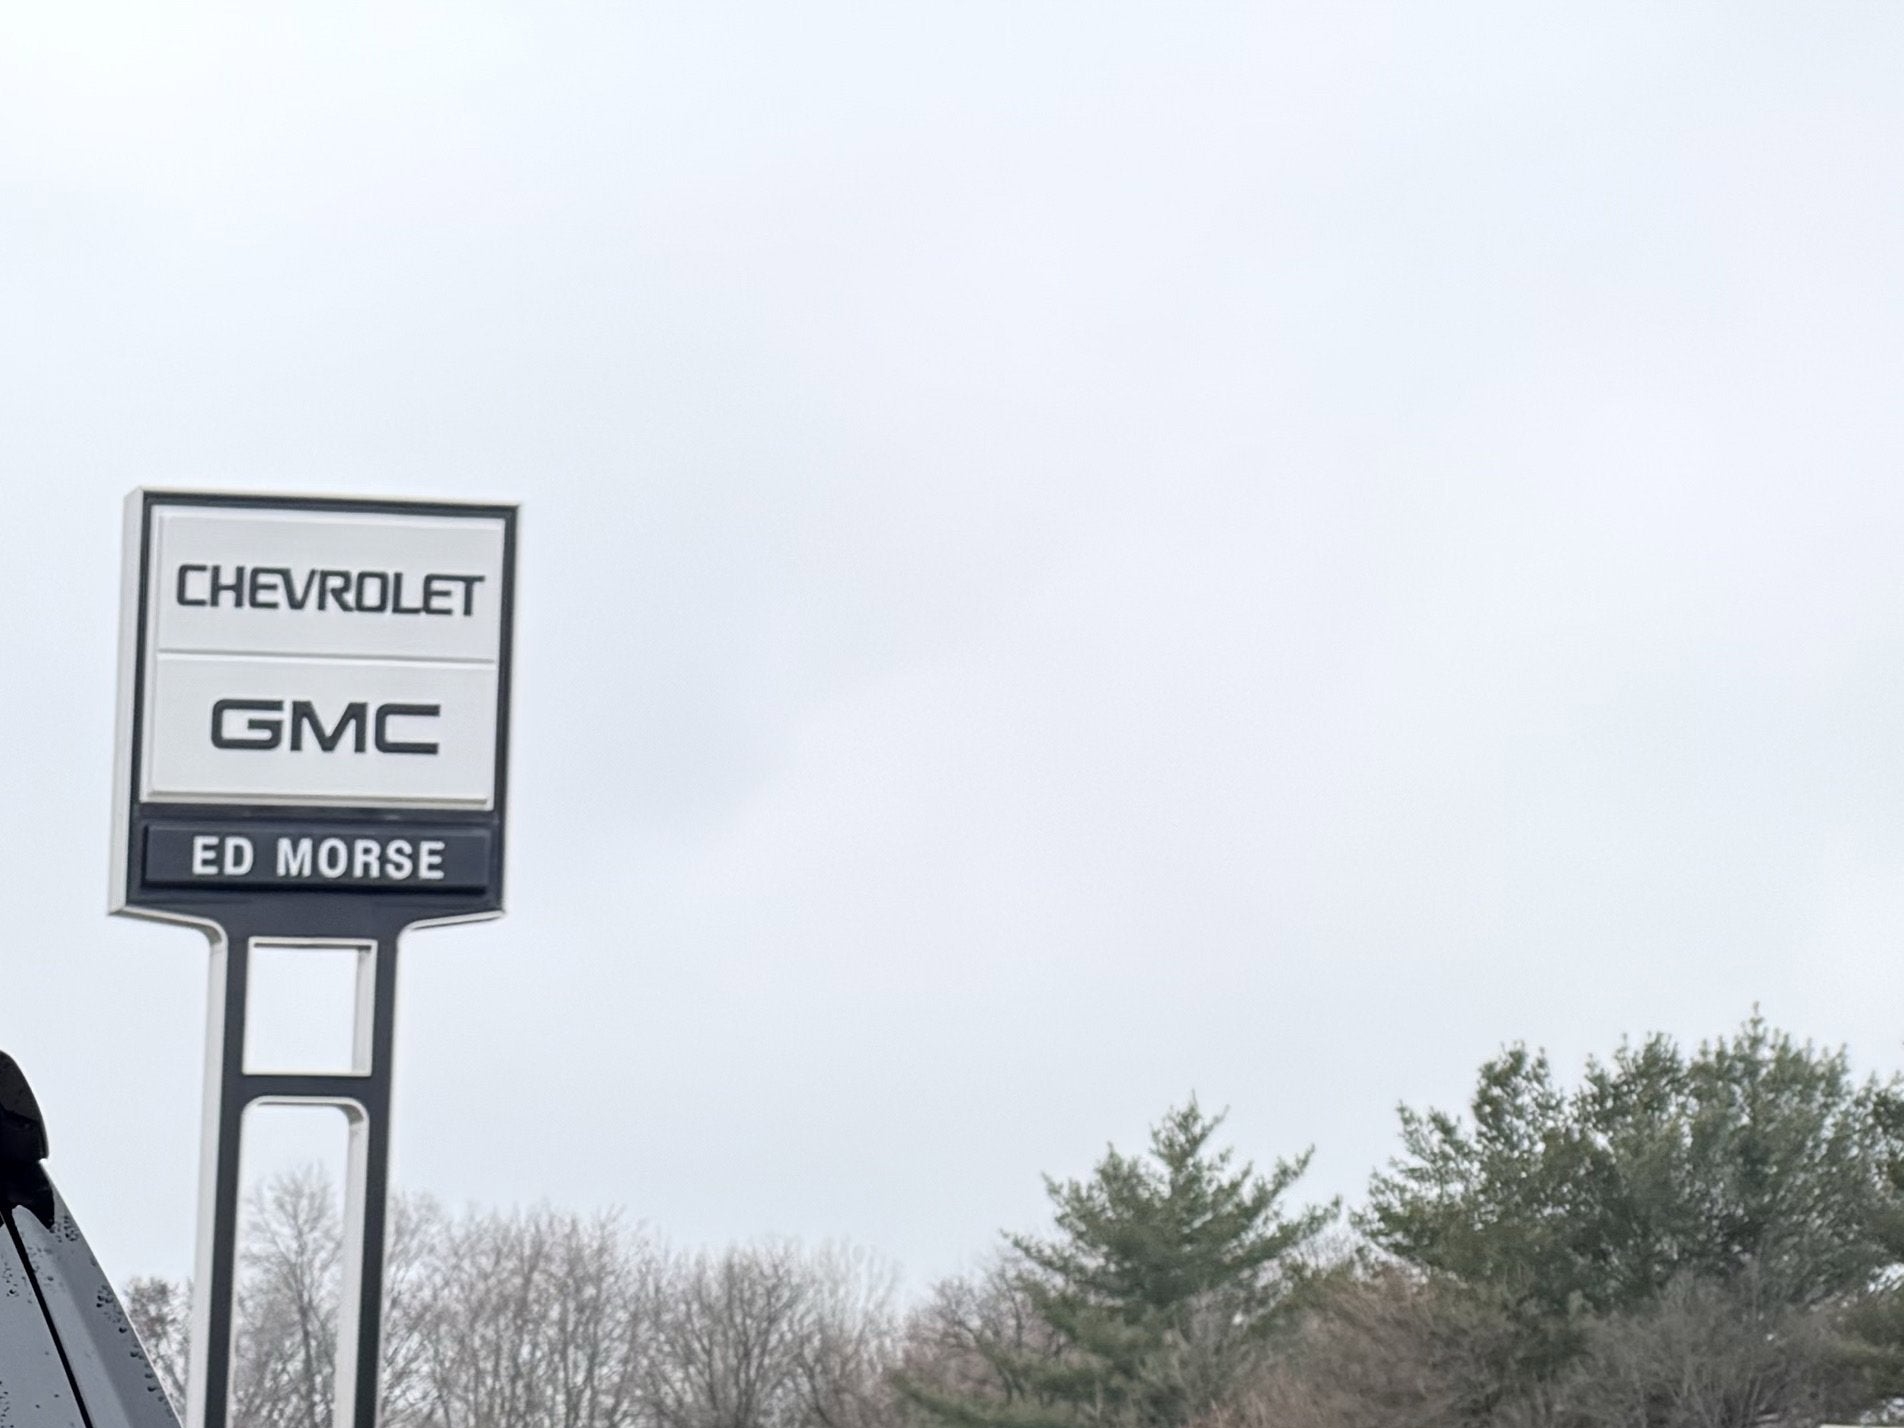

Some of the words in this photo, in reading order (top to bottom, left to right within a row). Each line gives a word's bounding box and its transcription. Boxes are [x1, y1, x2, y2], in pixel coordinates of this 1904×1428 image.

[176, 563, 485, 616] CHEVROLET
[211, 698, 441, 755] GMC
[192, 836, 254, 875] ED
[277, 838, 446, 880] MORSE
